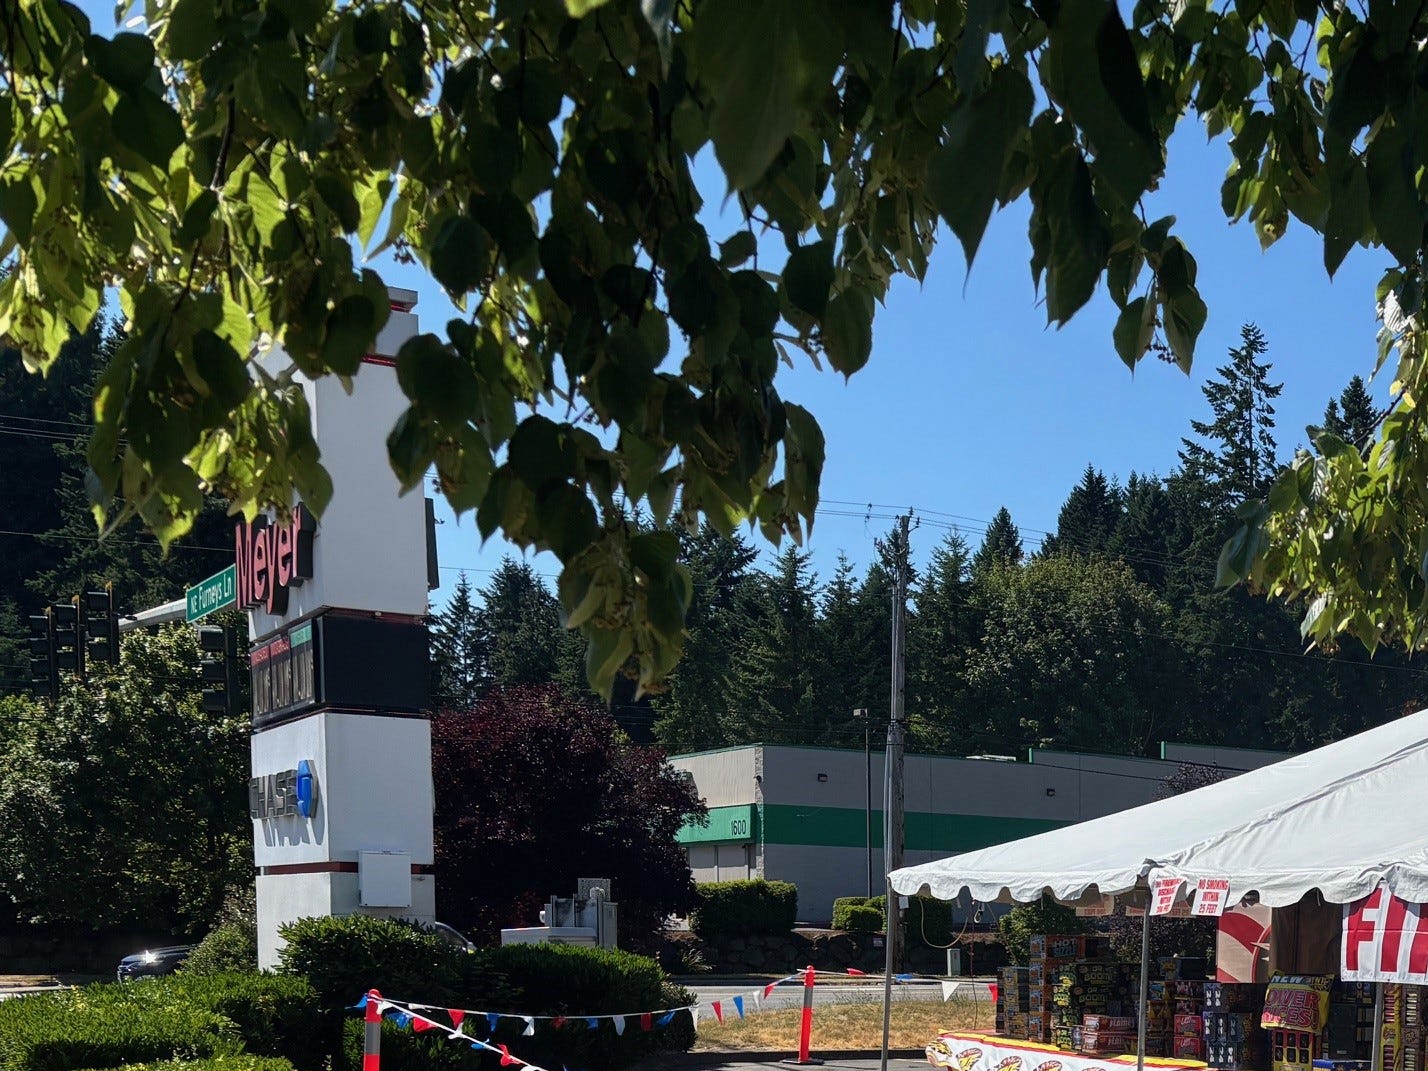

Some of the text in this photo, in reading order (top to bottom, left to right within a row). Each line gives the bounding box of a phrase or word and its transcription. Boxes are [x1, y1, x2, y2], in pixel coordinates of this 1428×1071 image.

[235, 507, 302, 615] Meyer
[190, 594, 198, 614] NE
[224, 574, 232, 598] Ln
[731, 820, 747, 836] 1600
[1198, 879, 1229, 890] NO SMOKING
